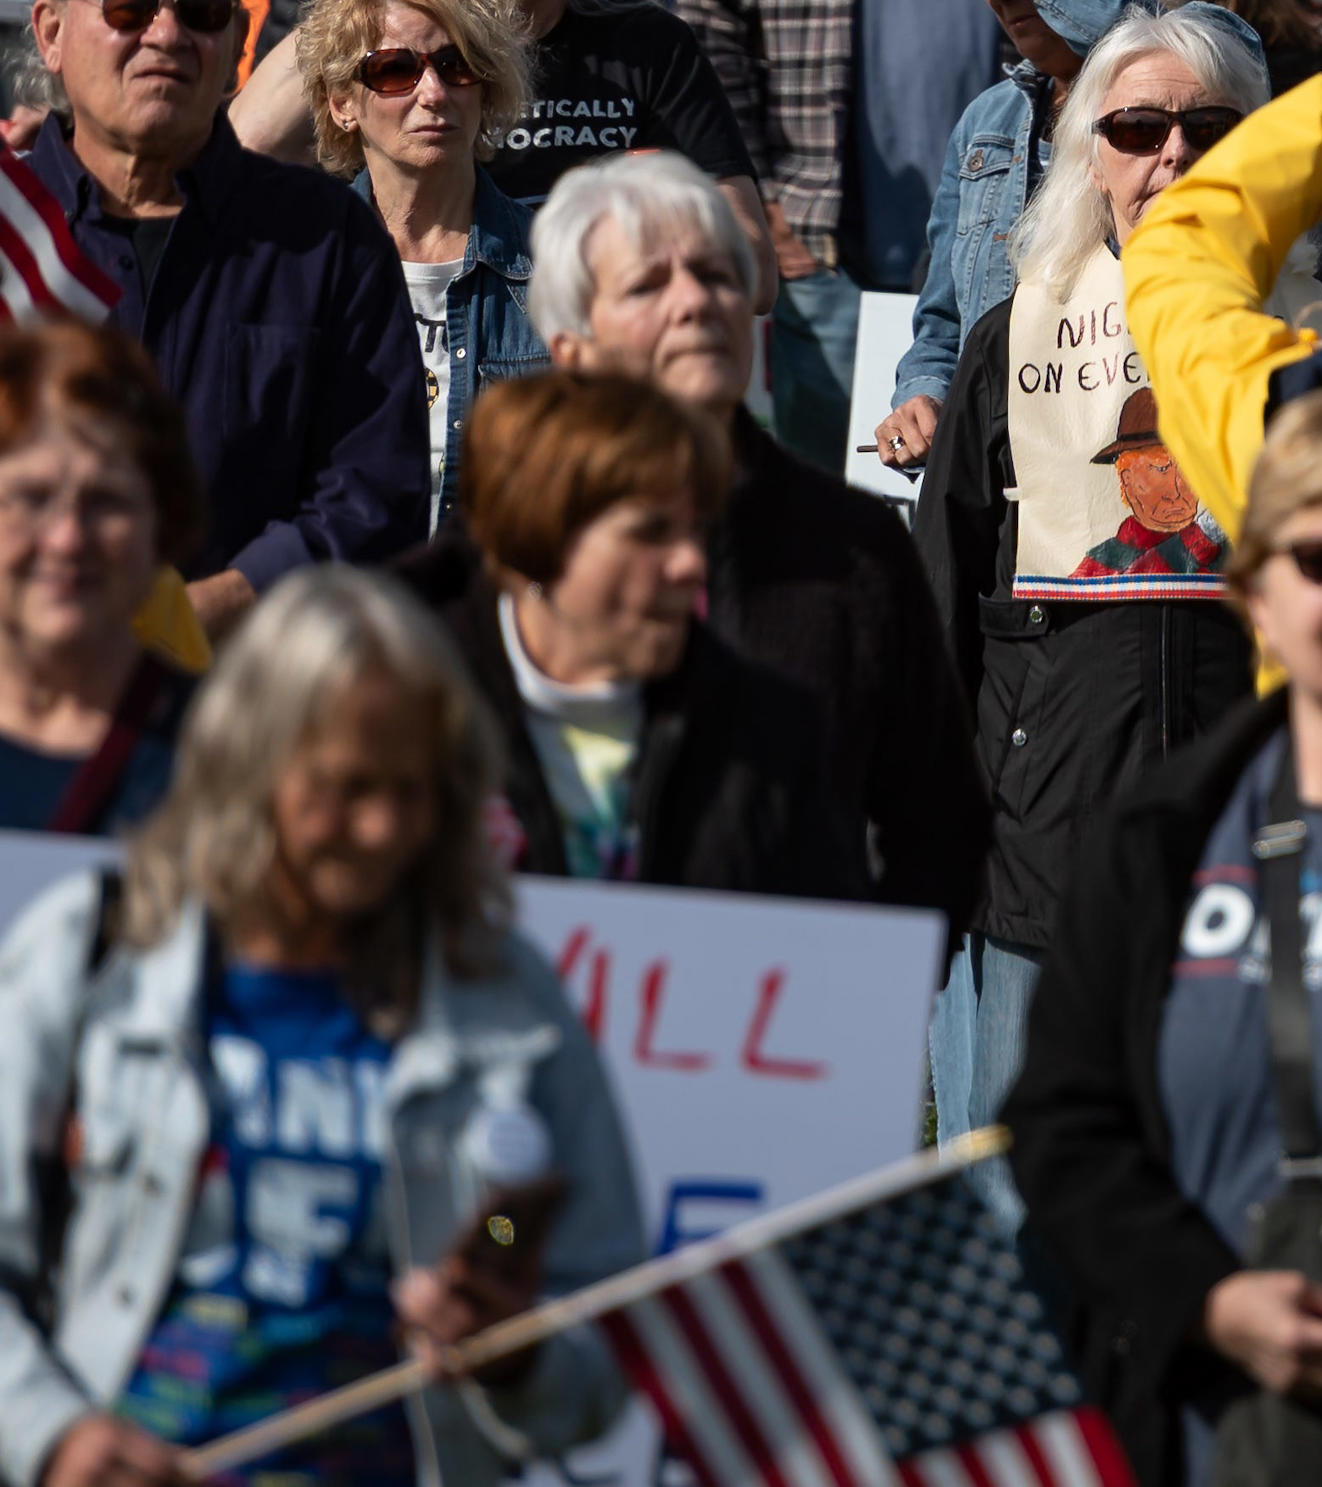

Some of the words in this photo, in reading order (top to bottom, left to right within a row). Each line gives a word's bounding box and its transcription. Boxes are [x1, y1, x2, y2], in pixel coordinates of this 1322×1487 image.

[1058, 301, 1132, 349] NIG
[1018, 361, 1063, 394] ON
[1078, 351, 1151, 391] EVE
[556, 925, 830, 1080] ILL
